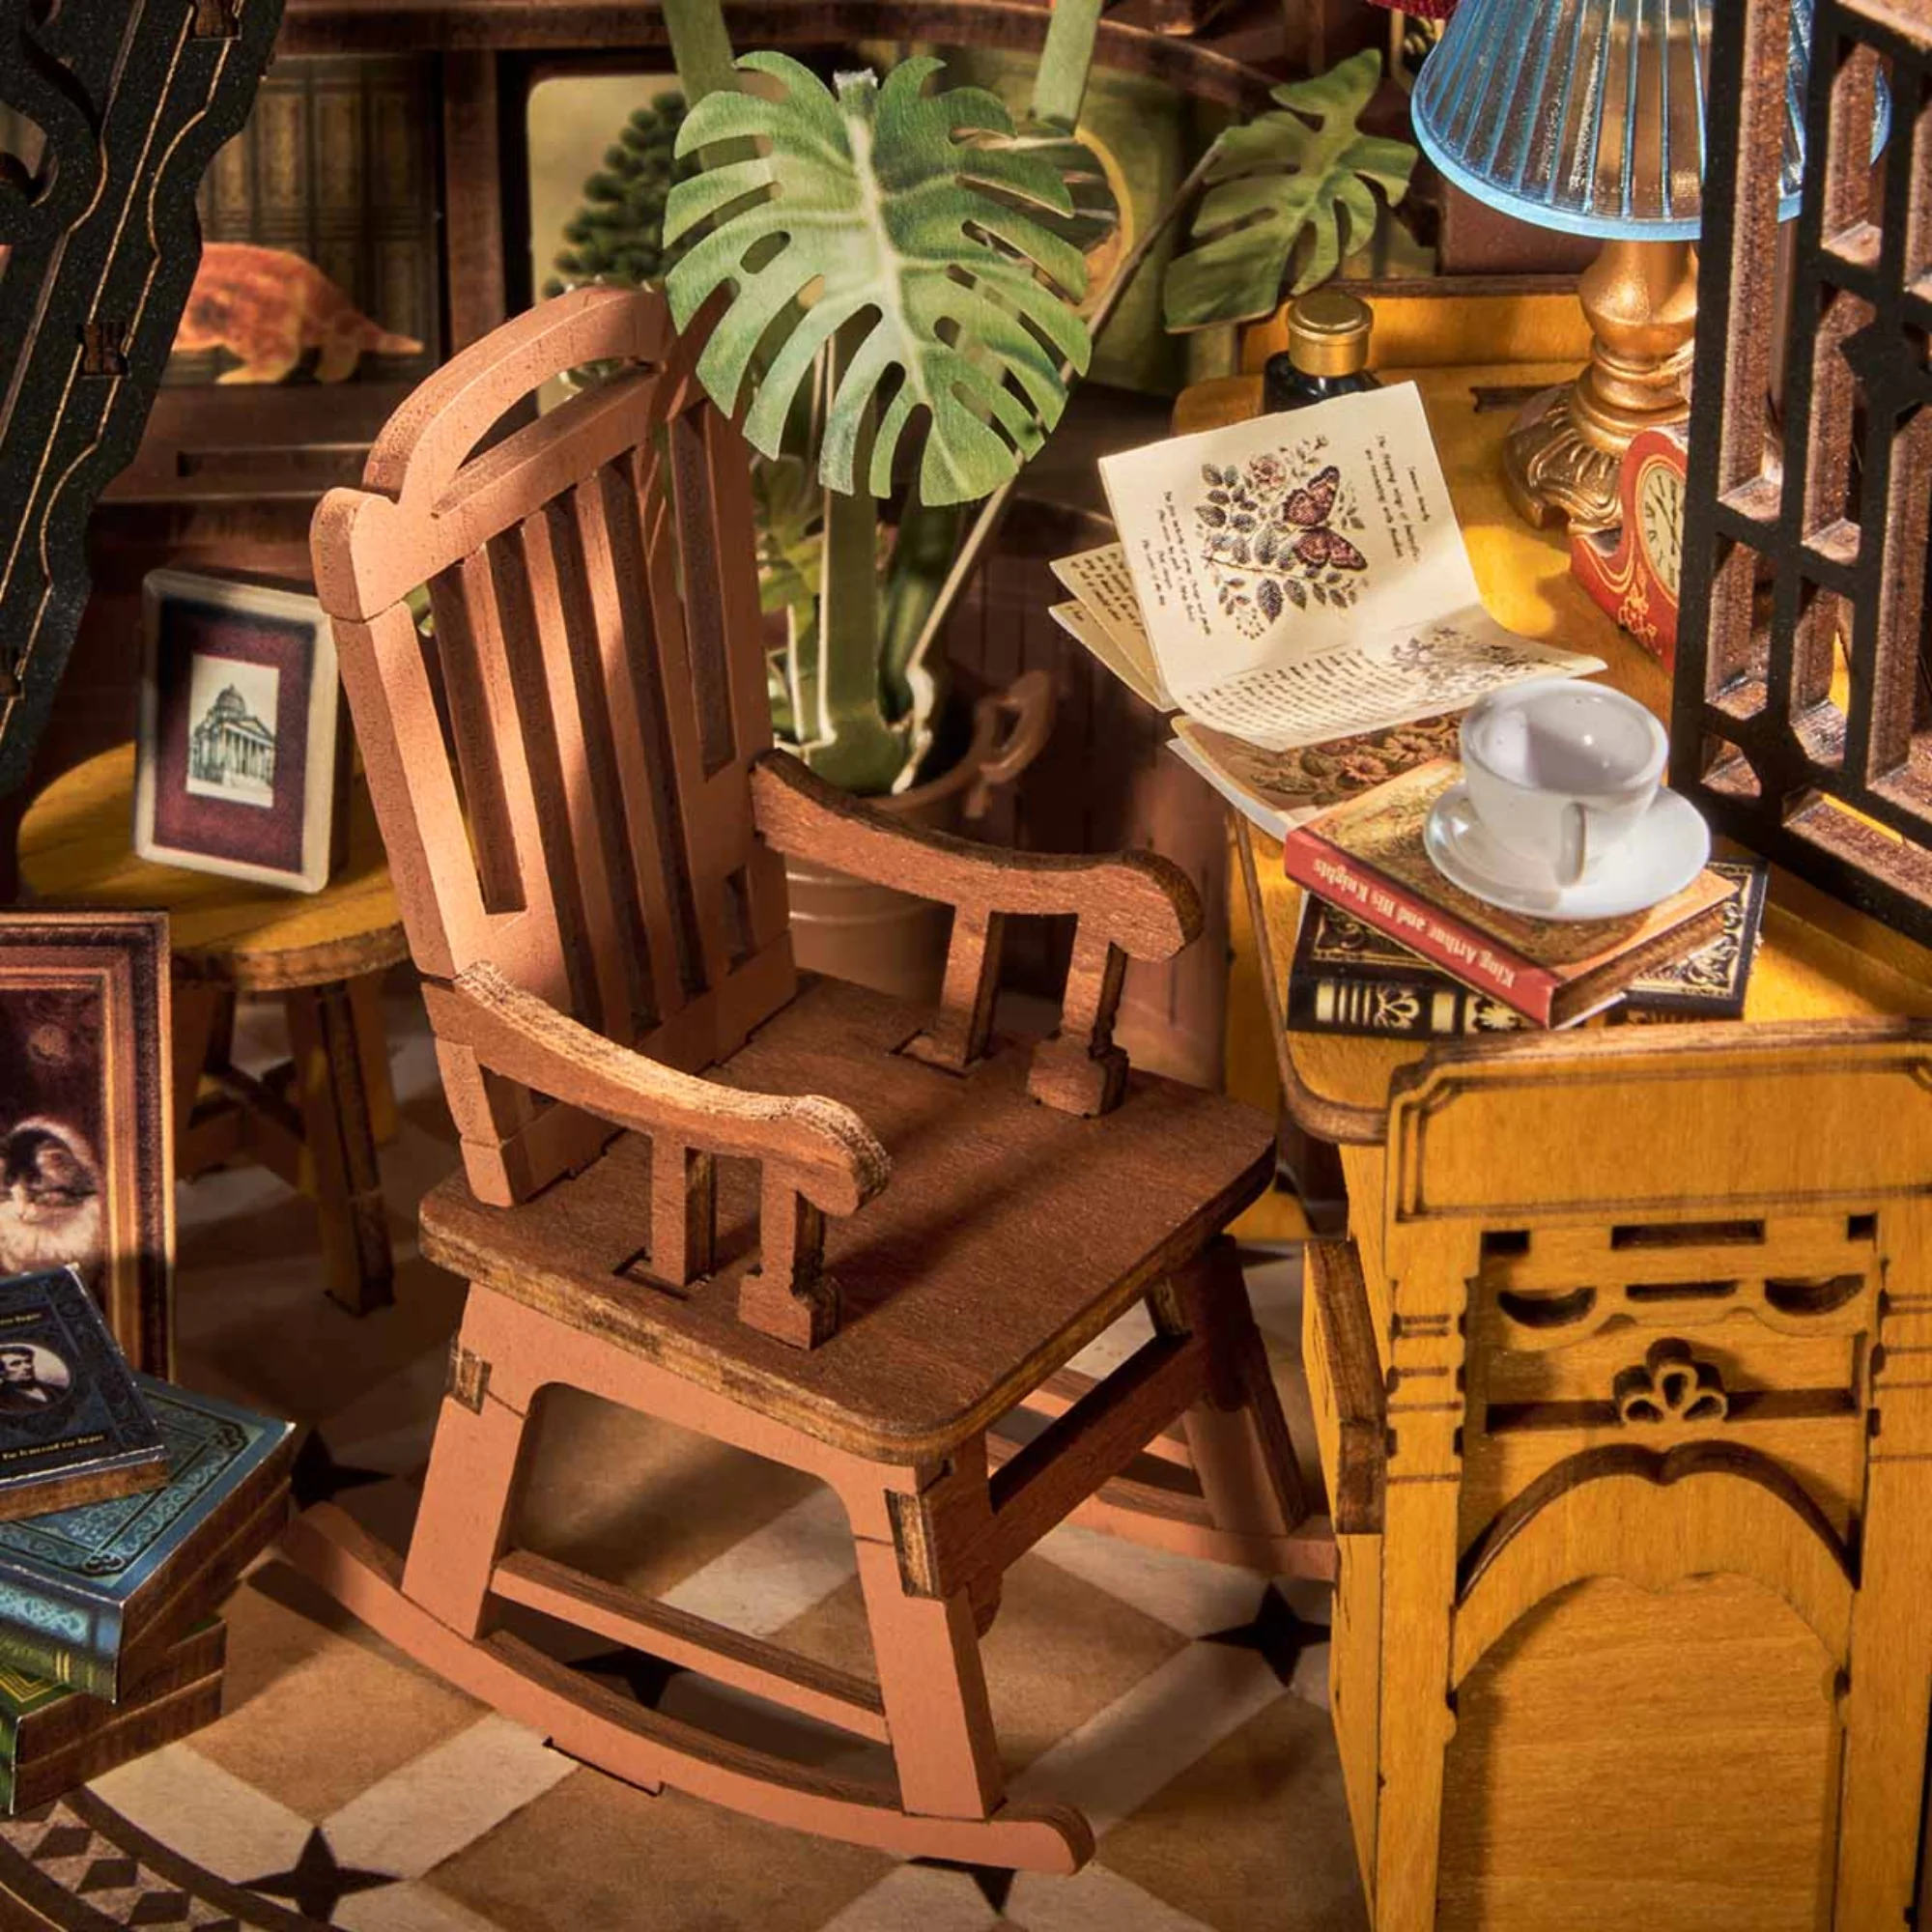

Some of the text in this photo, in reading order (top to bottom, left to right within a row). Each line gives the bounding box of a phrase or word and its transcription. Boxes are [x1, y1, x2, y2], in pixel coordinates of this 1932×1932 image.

[1314, 858, 1369, 902] Knights
[1396, 906, 1426, 931] and
[1427, 923, 1477, 964] Arthur
[1478, 950, 1517, 988] King
